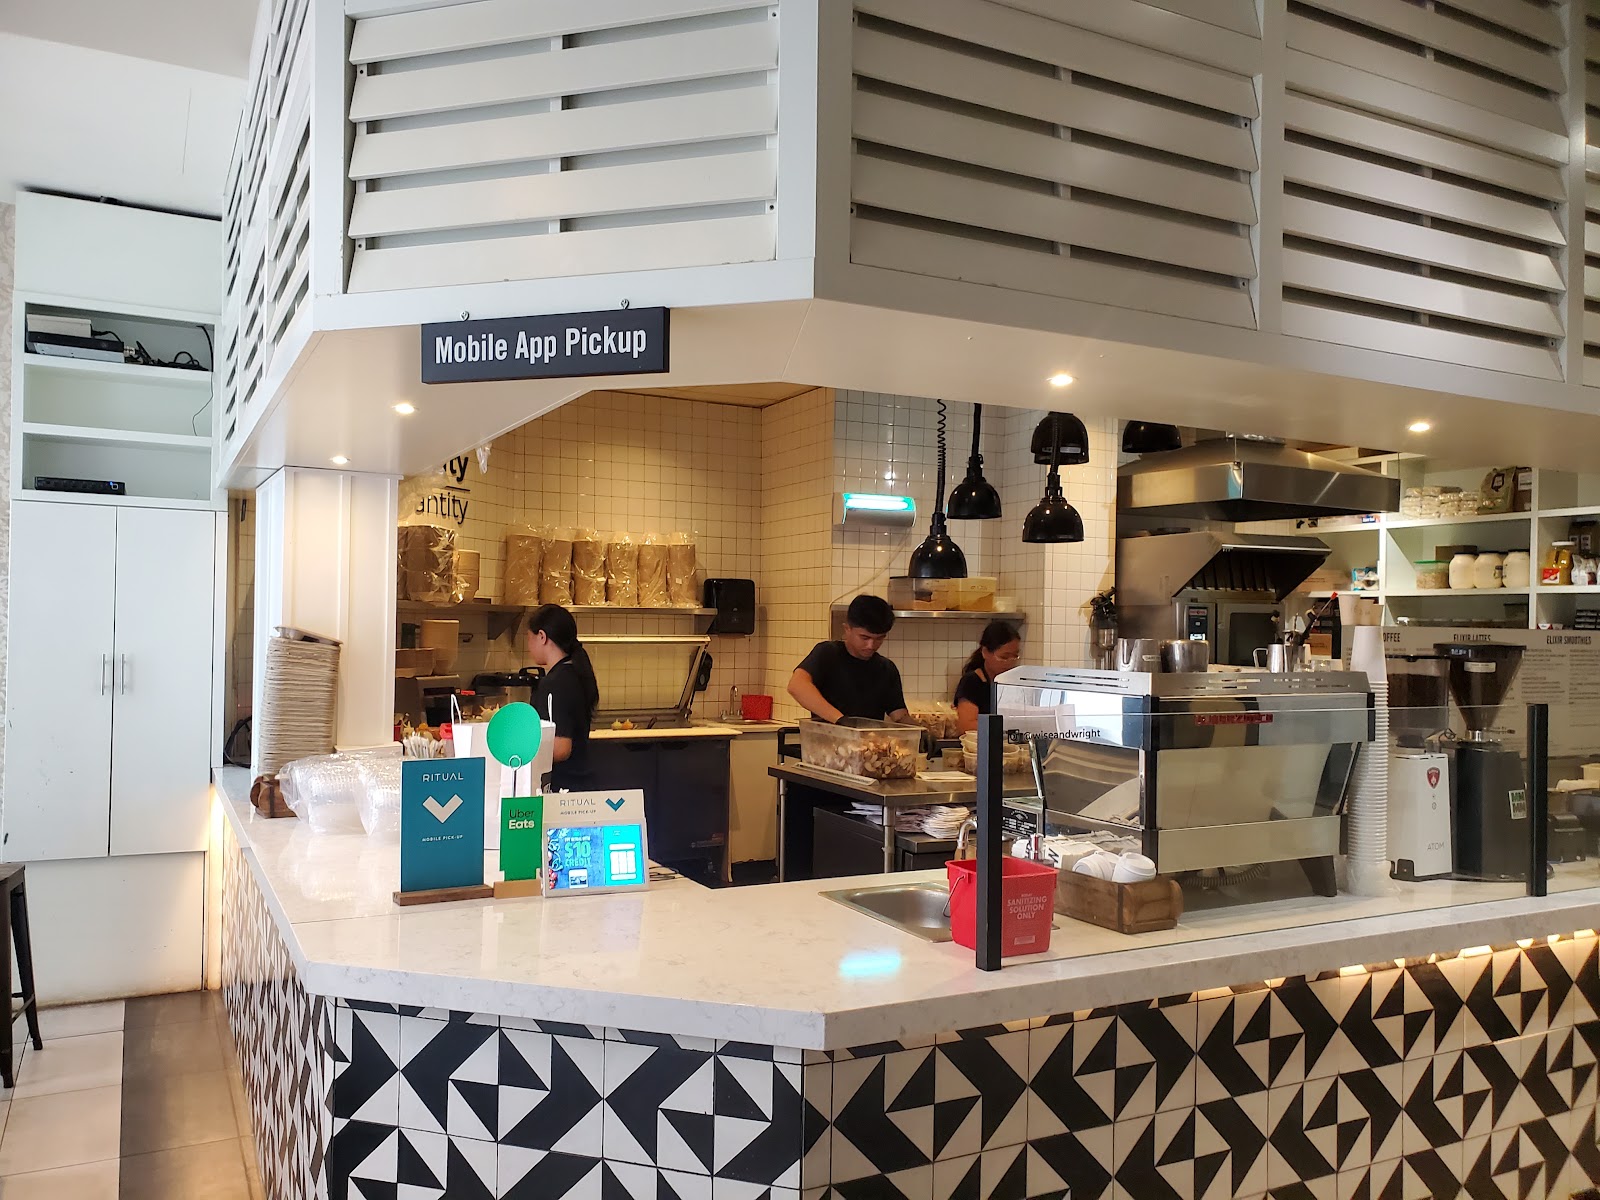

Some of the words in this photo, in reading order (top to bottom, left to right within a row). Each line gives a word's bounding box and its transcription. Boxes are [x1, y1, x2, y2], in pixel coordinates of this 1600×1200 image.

[434, 332, 508, 364] Mobile
[515, 330, 557, 365] App
[565, 326, 647, 360] Pickup
[415, 491, 469, 525] antity
[1383, 632, 1401, 643] OFFEE
[1546, 635, 1563, 645] ELIXIR
[1563, 636, 1592, 645] SMOOTHIES
[1023, 728, 1101, 741] @wiseandwright
[422, 772, 464, 783] RITUAL
[559, 798, 596, 807] RITUAL
[509, 809, 535, 819] Uber
[508, 819, 535, 830] Eats
[564, 841, 591, 859] $10
[1427, 841, 1445, 852] ATOM
[564, 856, 592, 867] CREDIT
[1007, 896, 1048, 907] SANITIZING
[1009, 904, 1045, 914] SOLUTION
[1016, 912, 1036, 920] ONLY
